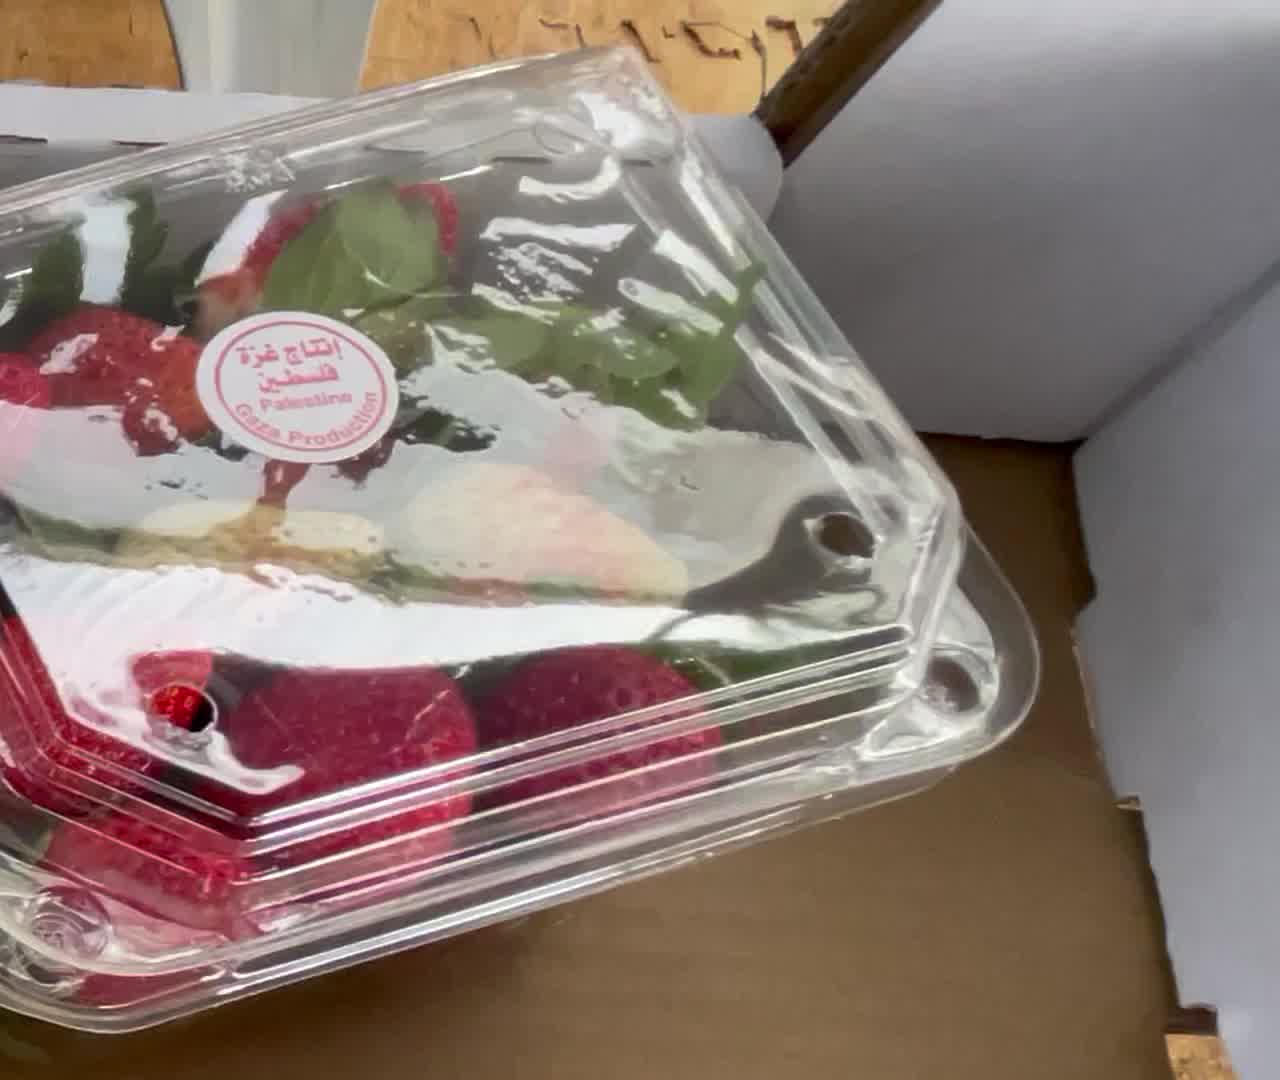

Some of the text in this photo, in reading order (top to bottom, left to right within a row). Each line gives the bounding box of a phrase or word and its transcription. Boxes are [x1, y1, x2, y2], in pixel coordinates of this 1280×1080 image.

[236, 337, 342, 368] إنتاج غزة
[258, 363, 339, 393] فلسطين
[288, 391, 376, 446] Production
